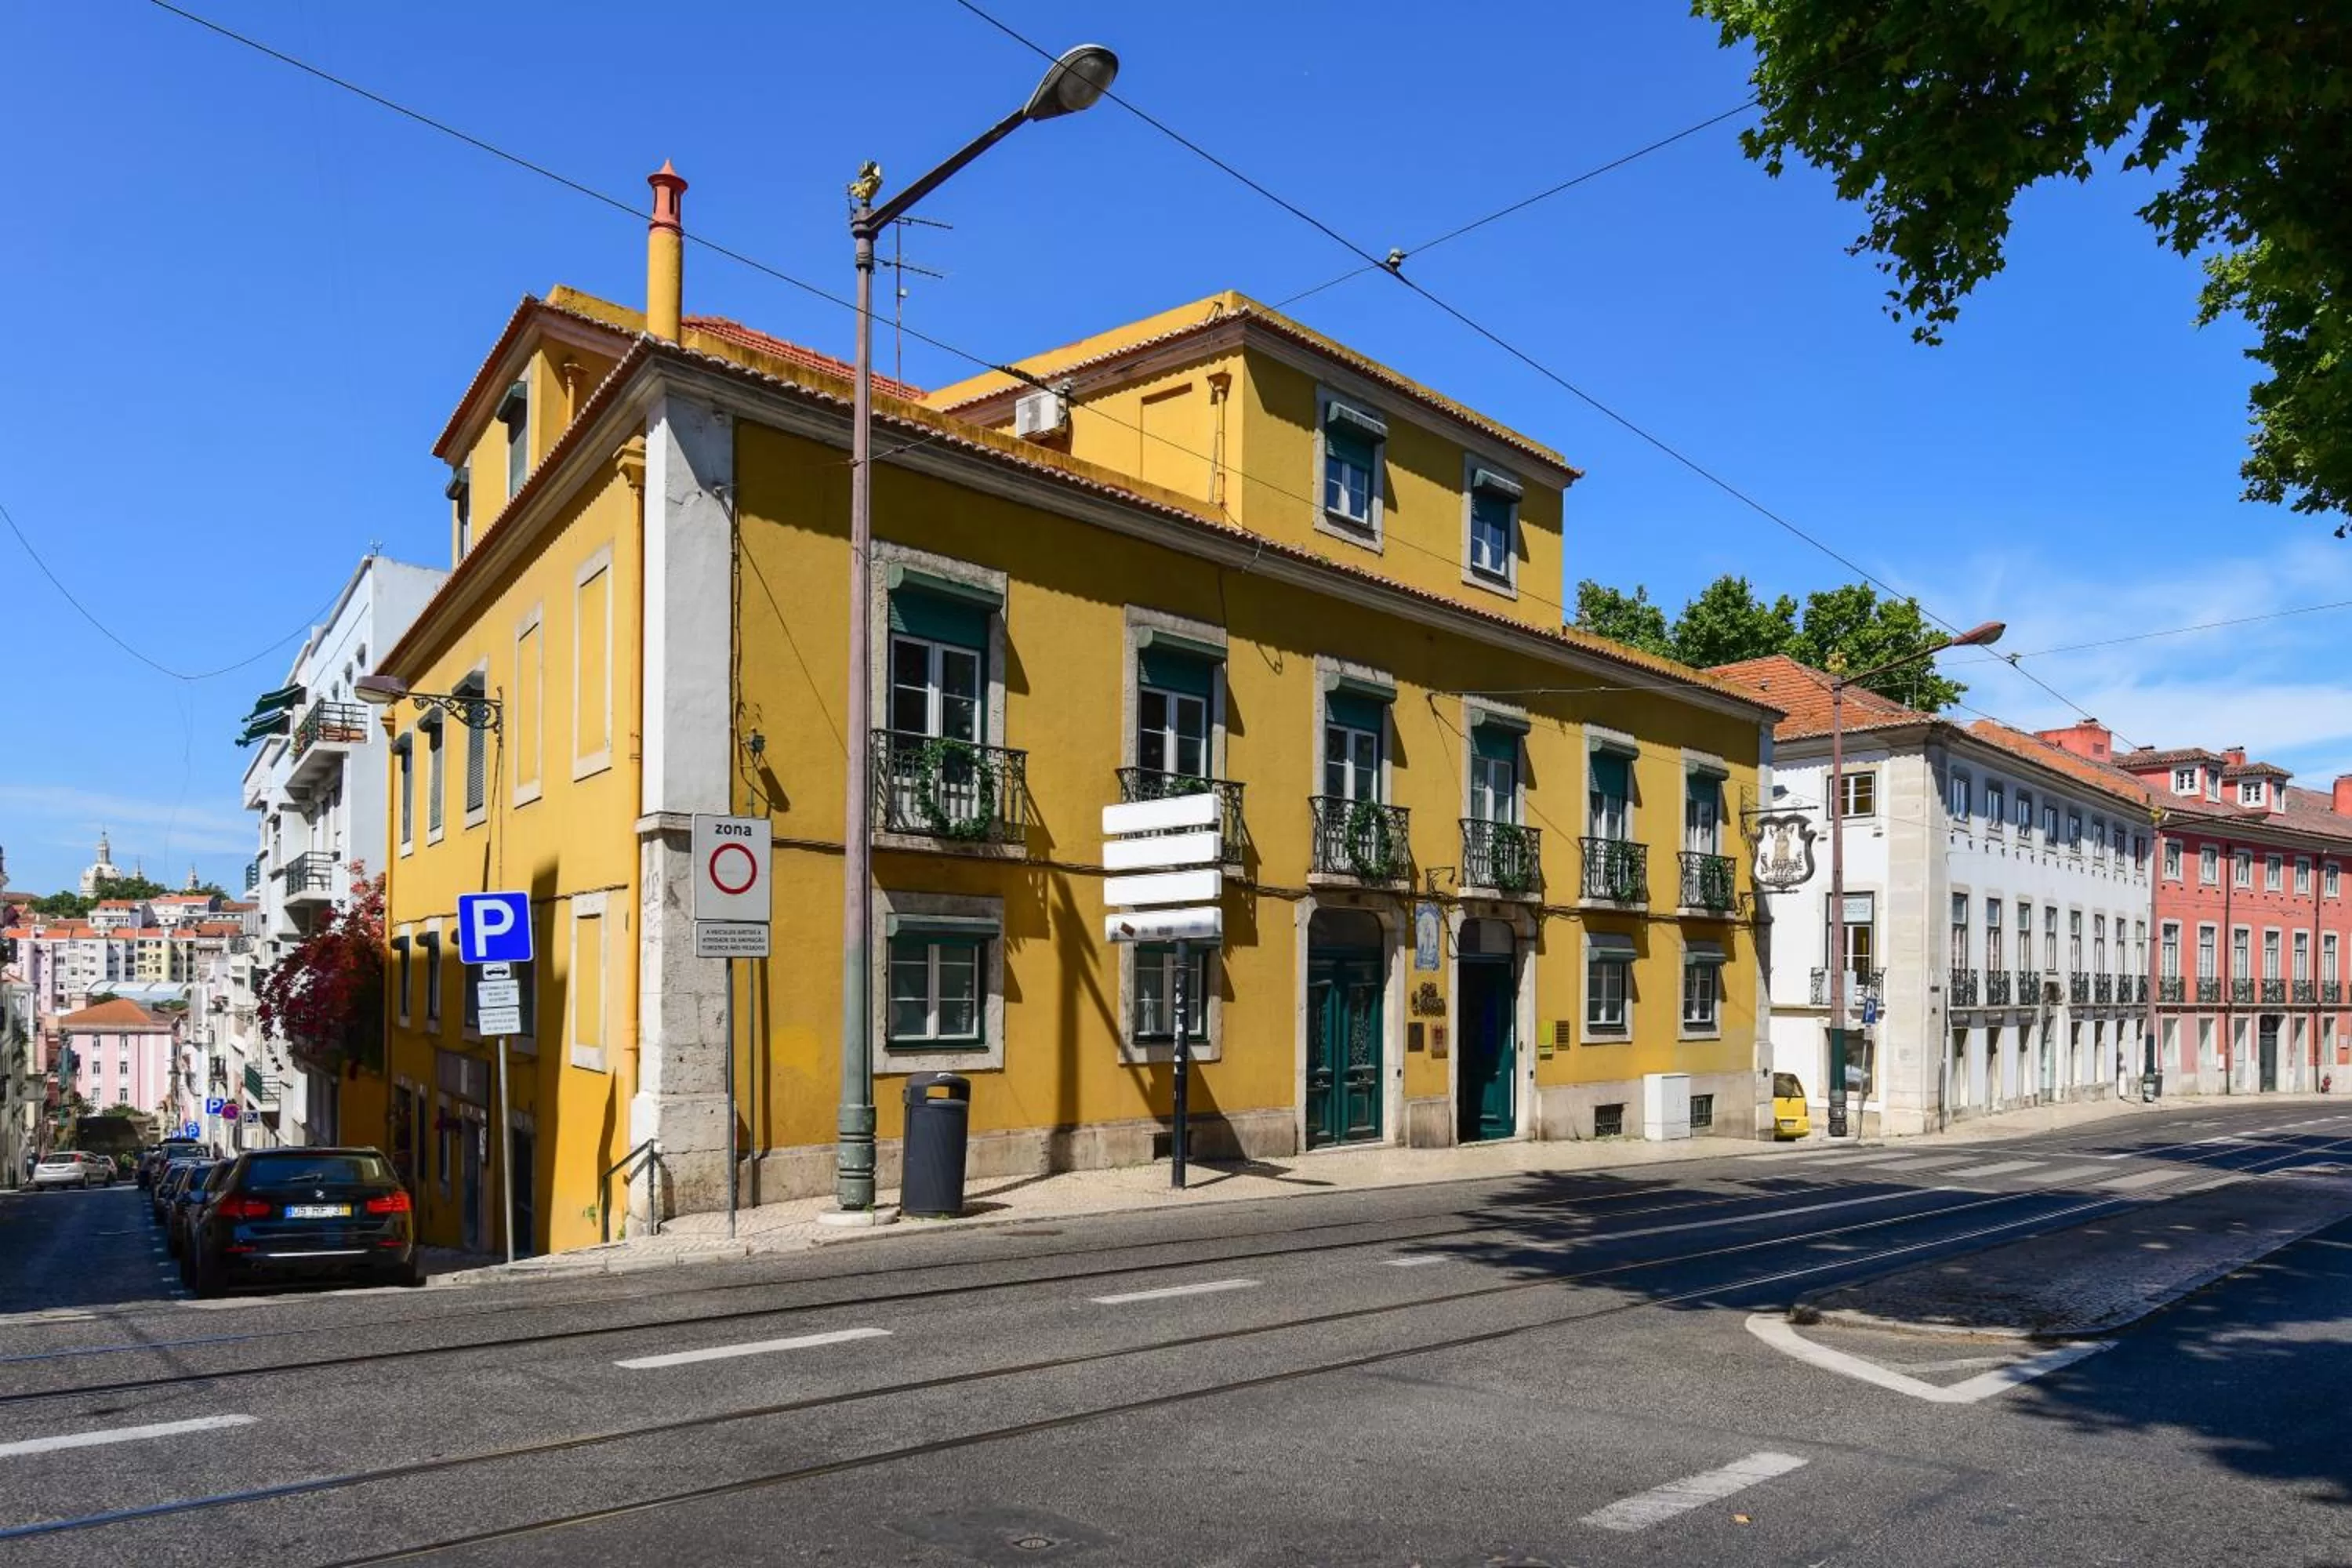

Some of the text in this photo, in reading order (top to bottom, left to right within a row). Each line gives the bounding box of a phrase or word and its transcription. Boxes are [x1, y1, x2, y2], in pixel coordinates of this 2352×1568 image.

[715, 824, 753, 837] zona
[472, 899, 515, 957] P
[1865, 1000, 1875, 1021] P
[209, 1100, 220, 1113] P
